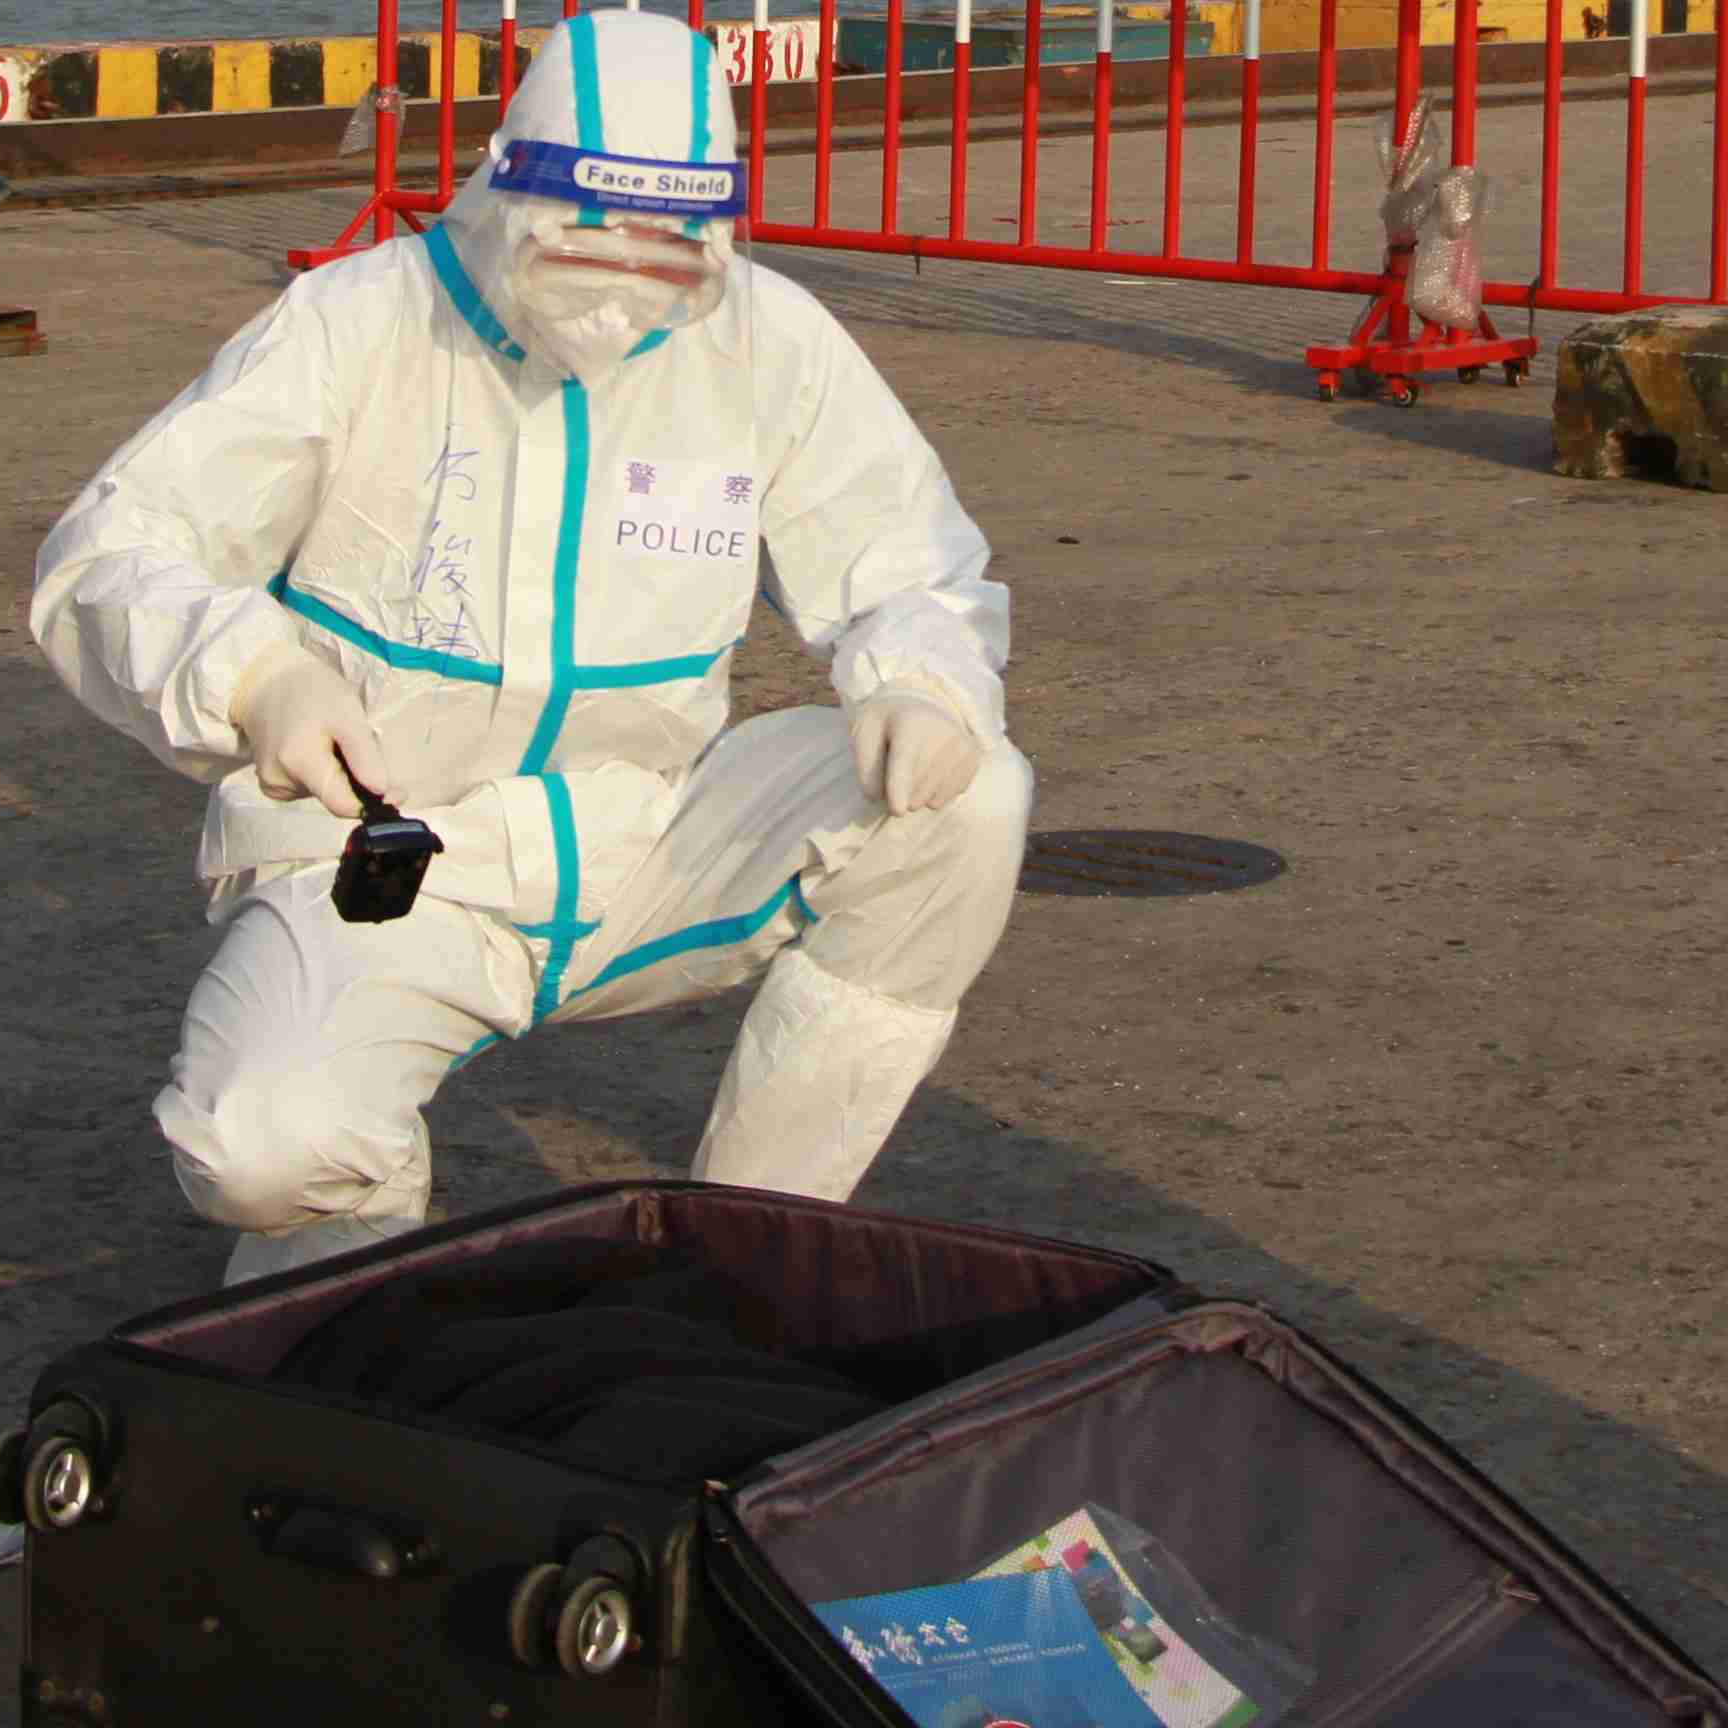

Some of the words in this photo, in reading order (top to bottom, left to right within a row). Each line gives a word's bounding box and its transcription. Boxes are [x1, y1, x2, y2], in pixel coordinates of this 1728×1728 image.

[586, 164, 646, 191] Face
[655, 173, 727, 196] Shield
[626, 460, 754, 505] 警察
[615, 519, 747, 559] POLICE
